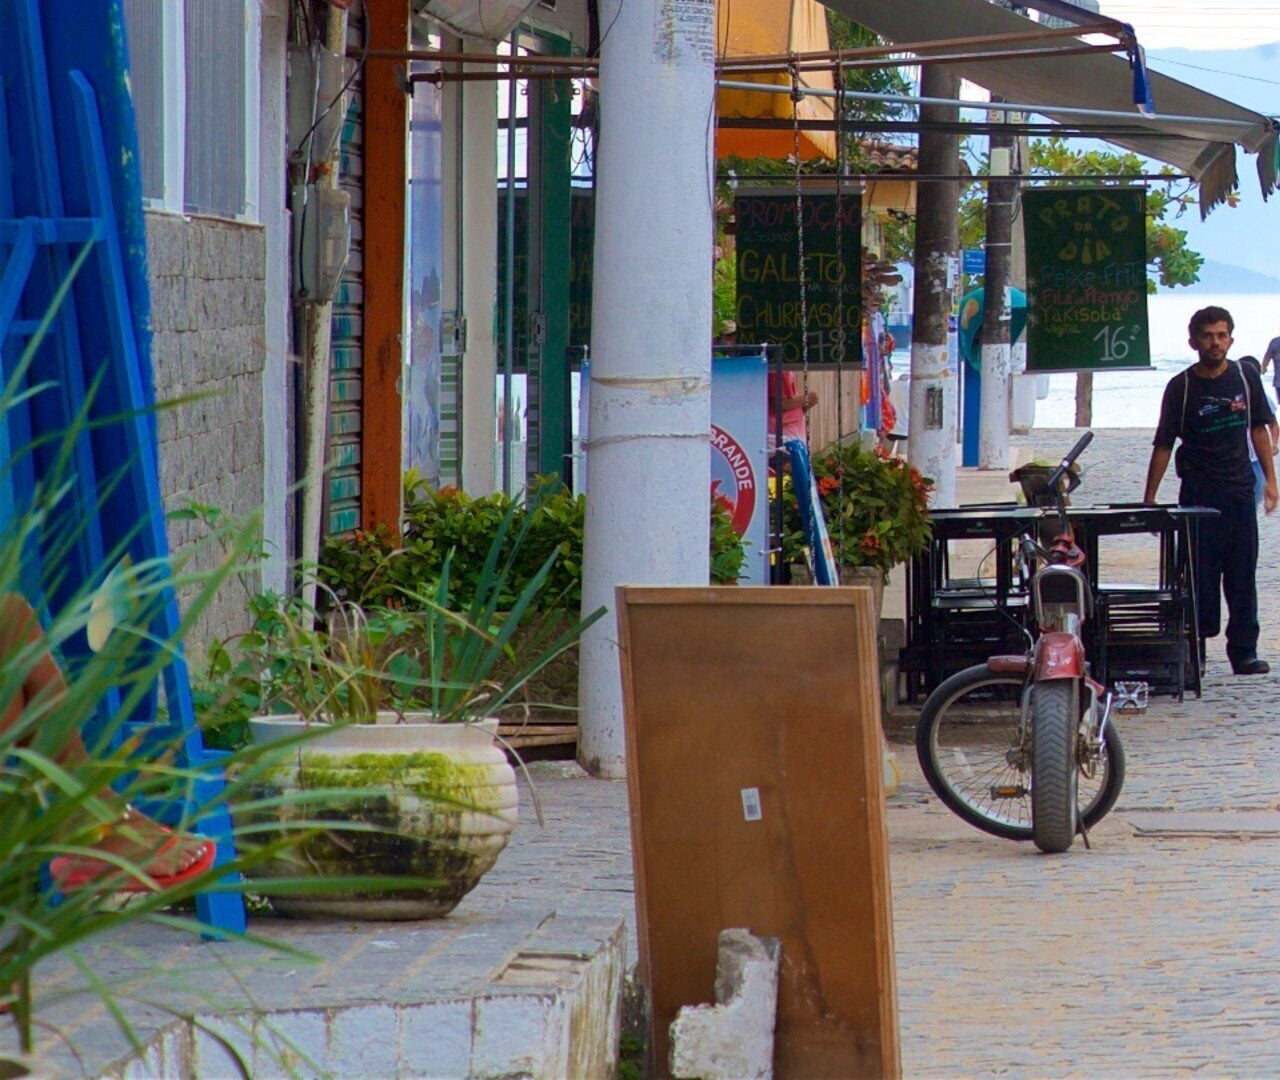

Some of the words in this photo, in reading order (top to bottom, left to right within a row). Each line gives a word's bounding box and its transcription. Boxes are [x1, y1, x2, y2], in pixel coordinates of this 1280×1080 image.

[1040, 194, 1129, 232] PRATO
[740, 249, 847, 283] GALETO
[737, 294, 861, 329] CHURRASCO
